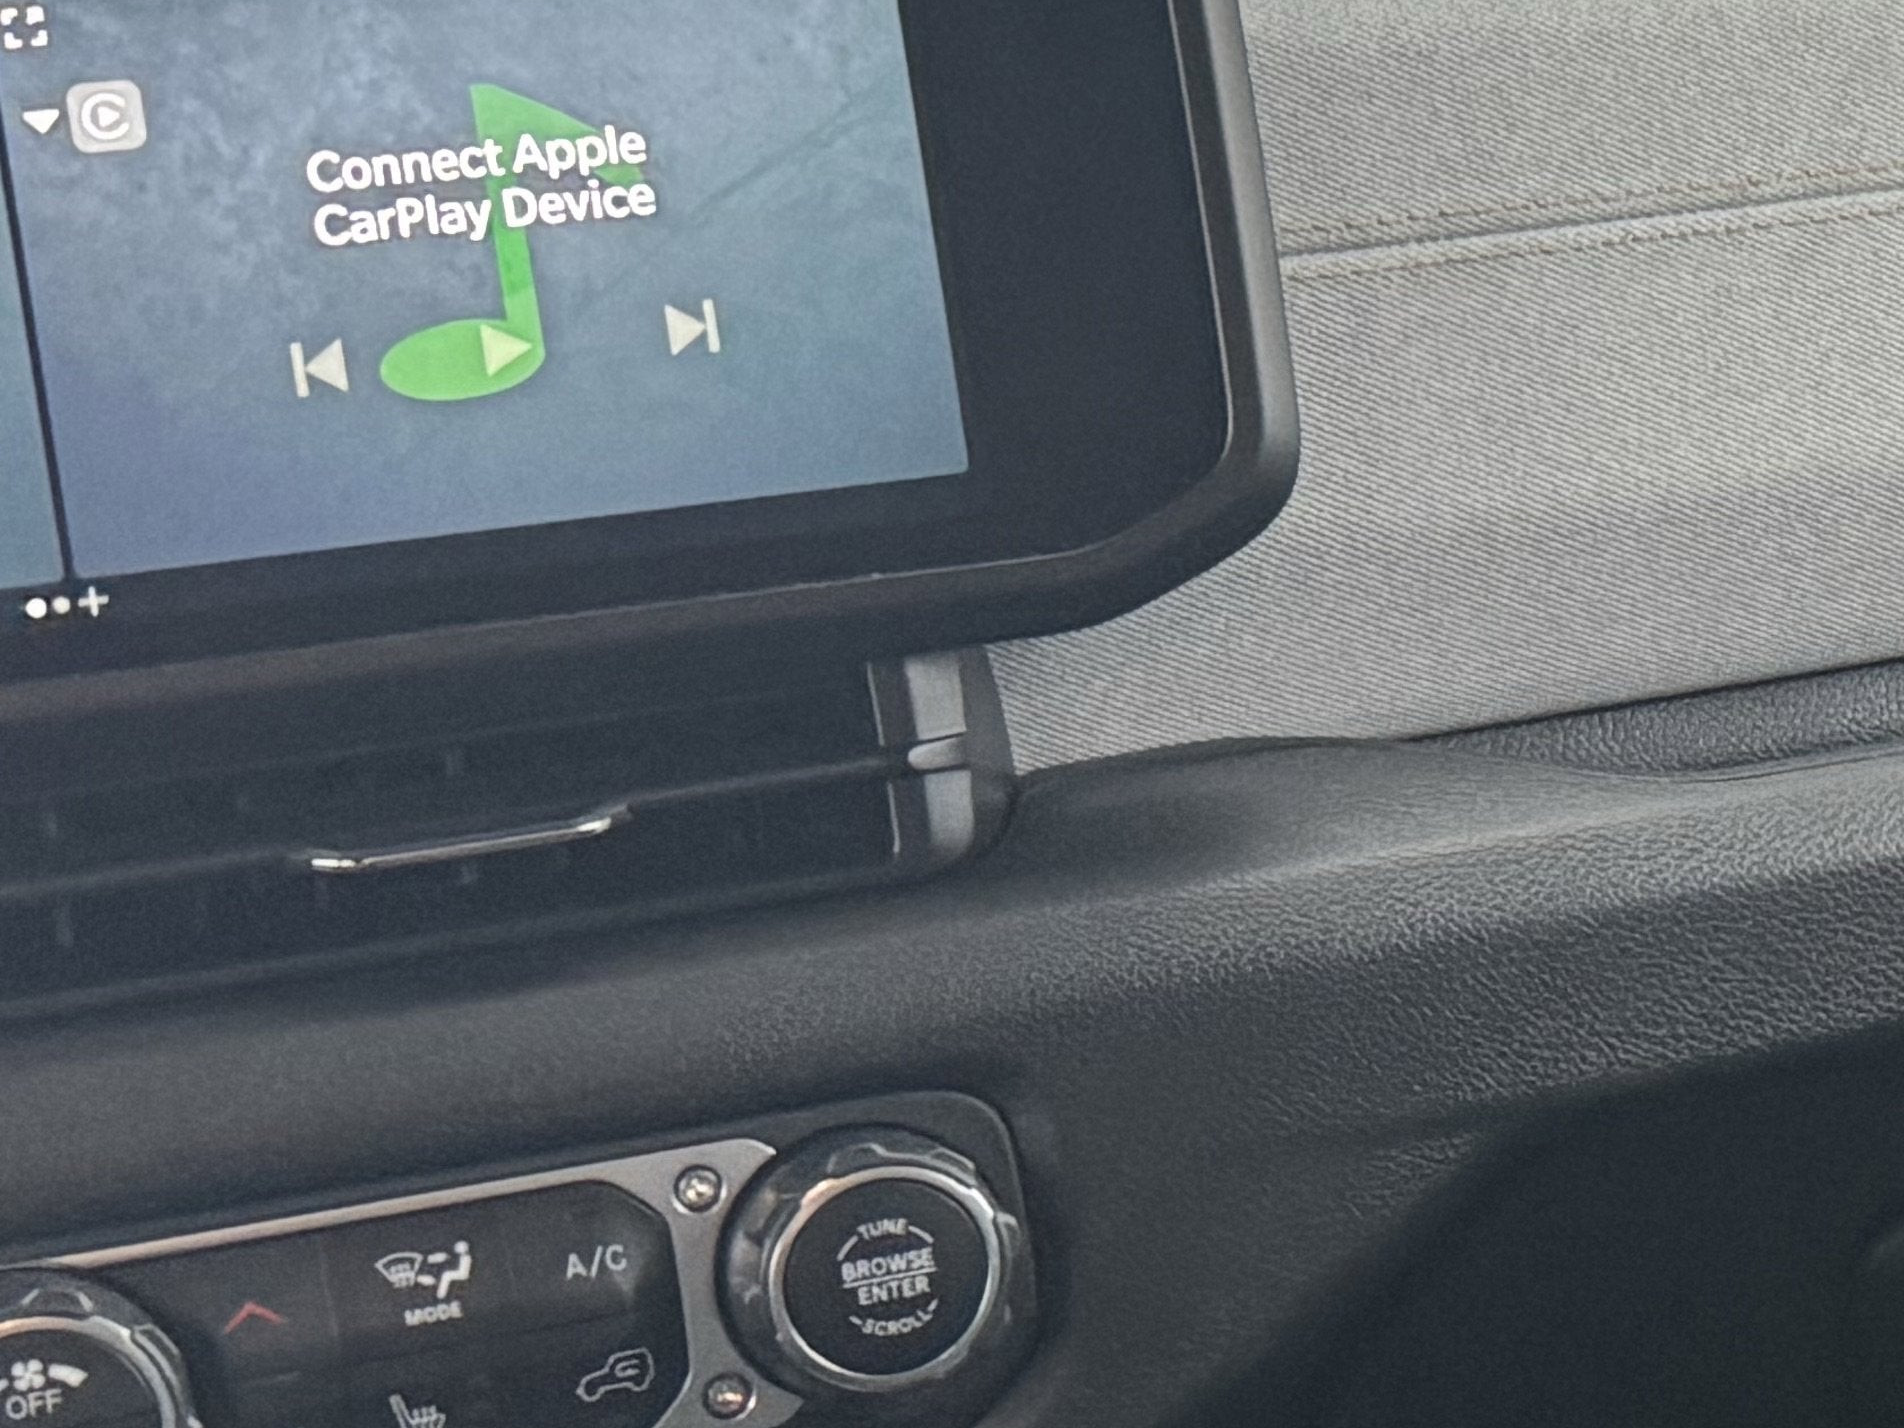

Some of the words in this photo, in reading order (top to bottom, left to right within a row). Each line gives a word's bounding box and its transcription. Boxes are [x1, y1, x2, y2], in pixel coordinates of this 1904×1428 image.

[305, 137, 507, 194] Connect
[512, 124, 648, 180] Apple
[313, 194, 492, 247] CarPlay
[501, 178, 657, 228] Device
[855, 1217, 910, 1241] TUNE
[565, 1243, 629, 1280] A/C
[840, 1245, 937, 1282] BROWSE
[857, 1275, 932, 1307] ENTER
[402, 1298, 465, 1328] MODE
[860, 1308, 935, 1338] SCROLL
[5, 1387, 64, 1421] OFF
